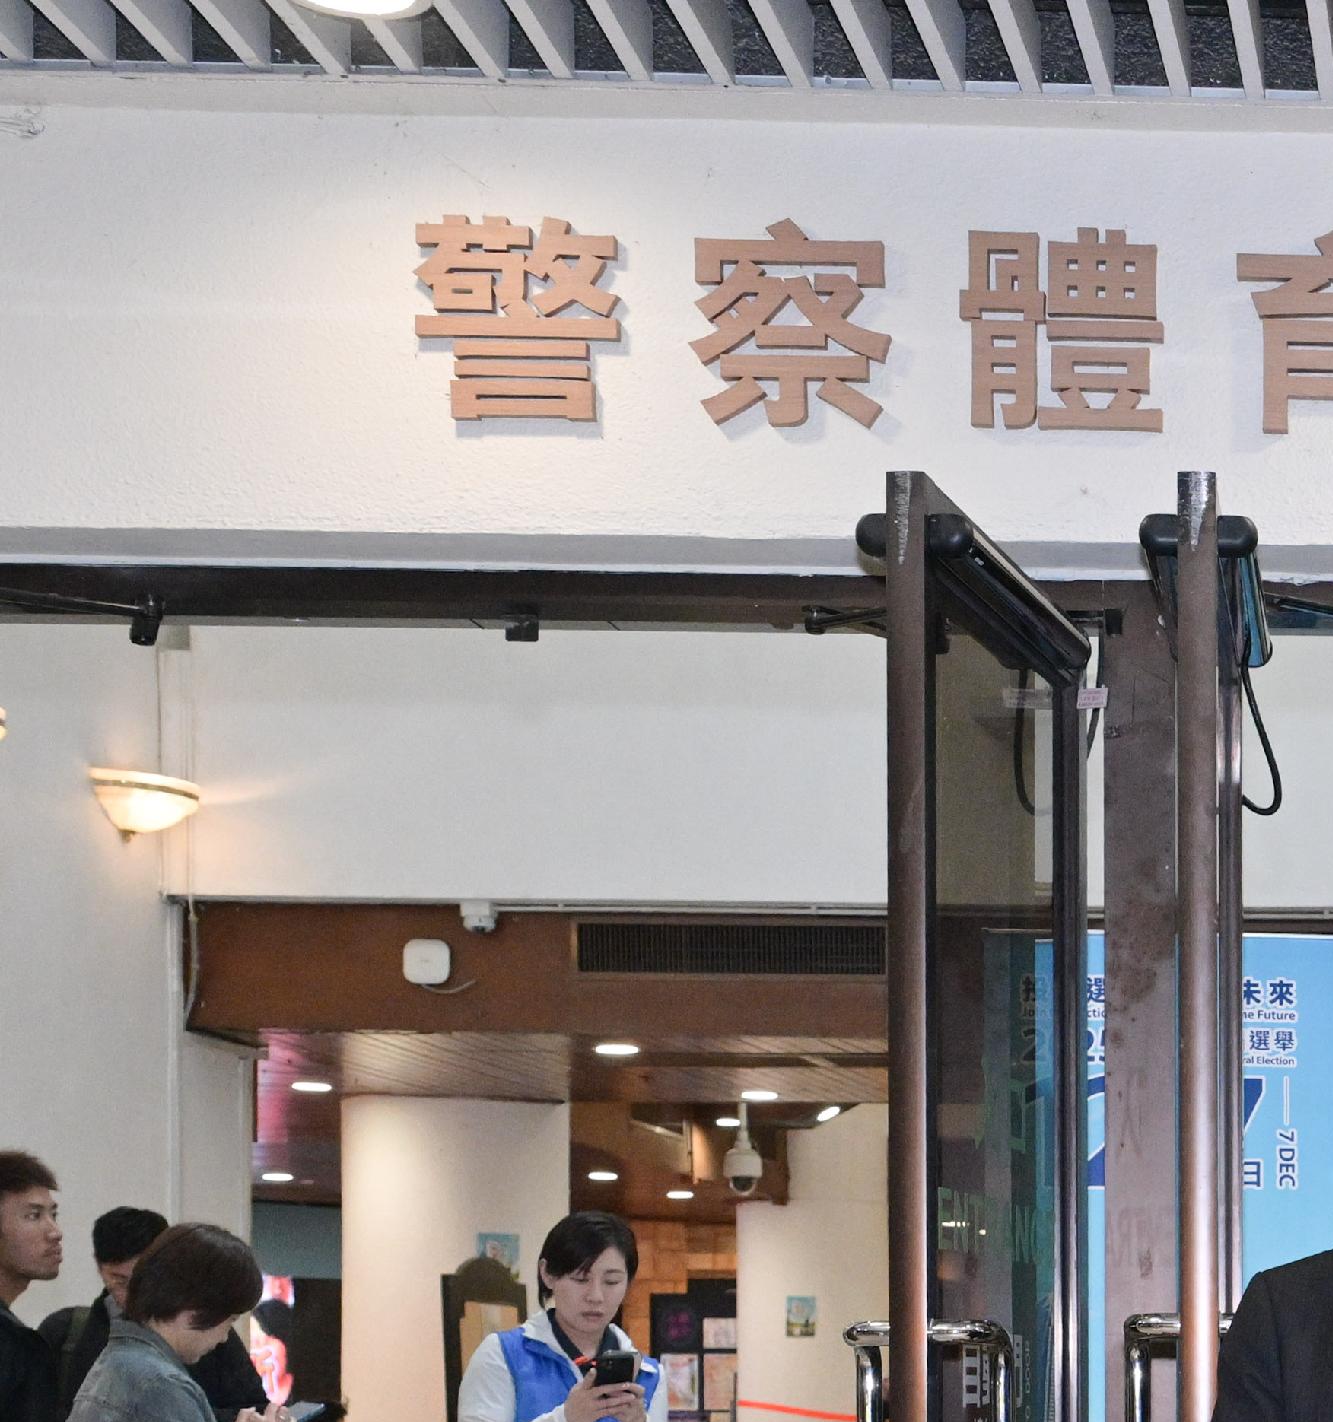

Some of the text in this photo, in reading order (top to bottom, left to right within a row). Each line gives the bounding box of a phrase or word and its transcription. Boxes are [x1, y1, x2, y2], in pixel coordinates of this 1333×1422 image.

[1243, 980, 1294, 1007] 未來
[1257, 1009, 1296, 1020] Future
[1249, 1030, 1294, 1051] 選舉
[1256, 1056, 1295, 1065] Election
[1279, 1148, 1295, 1187] DEC
